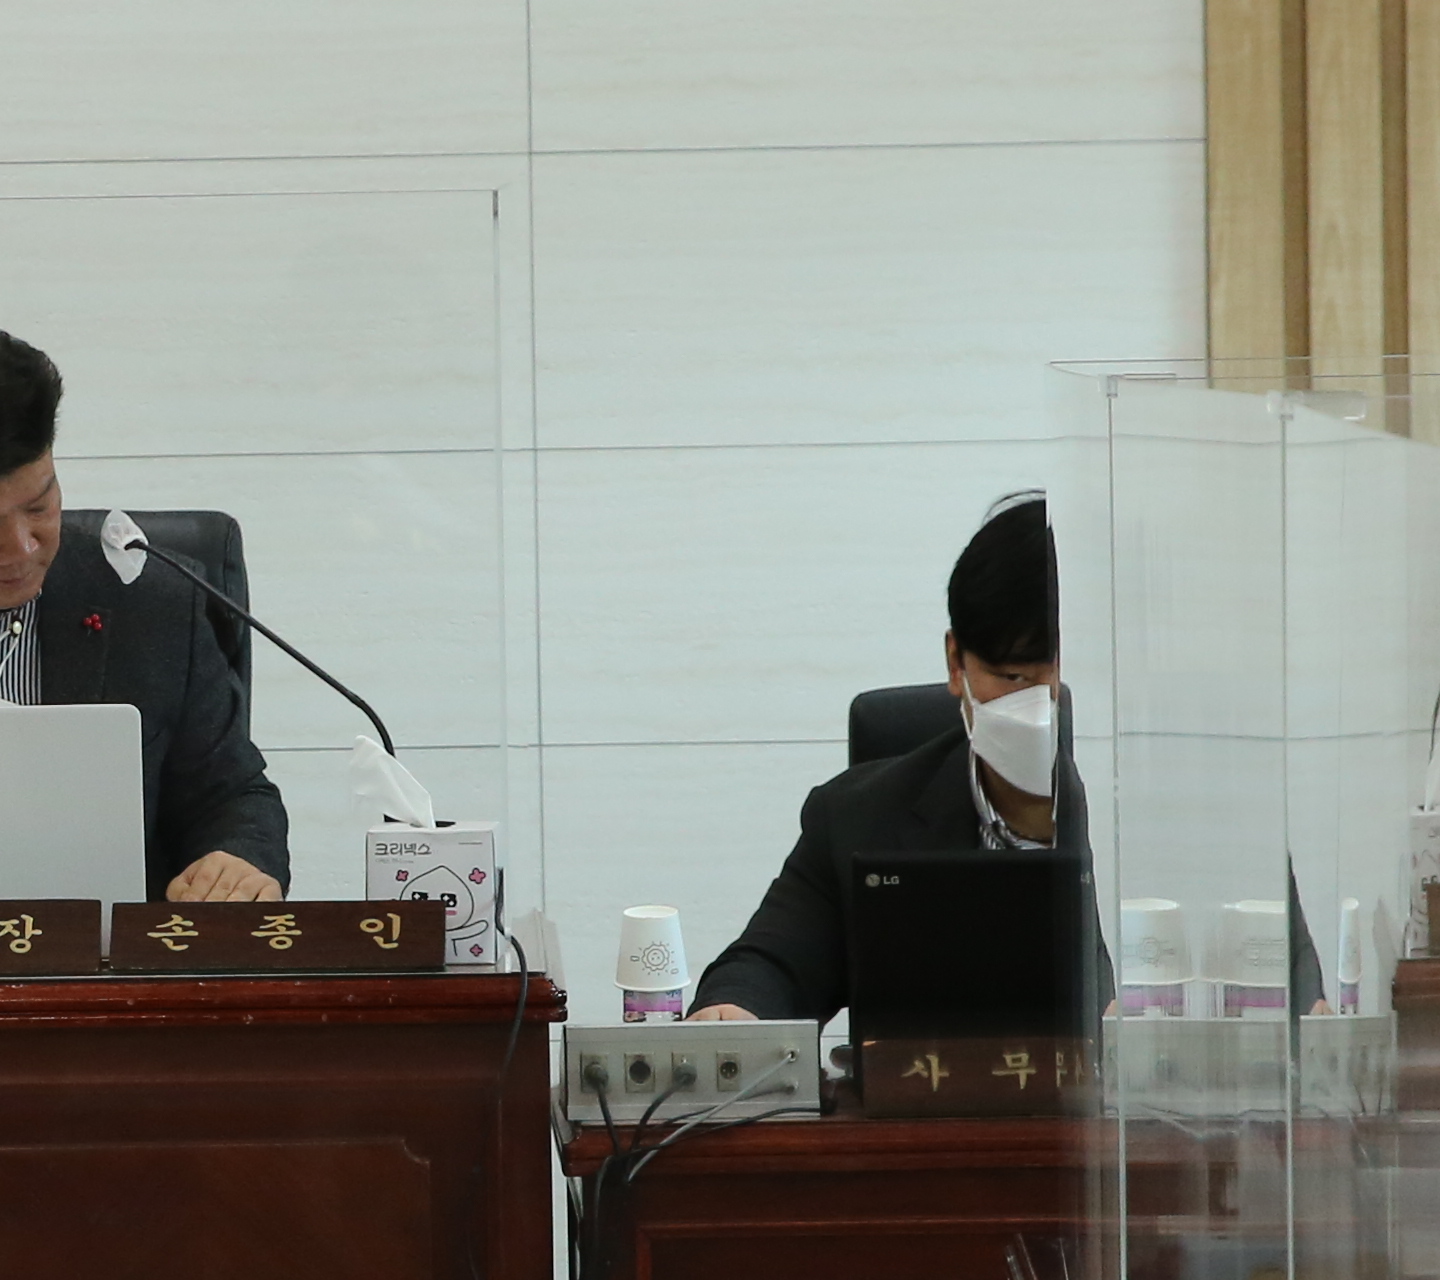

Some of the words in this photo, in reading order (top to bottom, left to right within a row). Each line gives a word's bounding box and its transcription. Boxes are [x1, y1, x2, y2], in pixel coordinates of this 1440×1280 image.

[374, 841, 432, 857] 크리넥스
[882, 875, 900, 885] LG
[146, 912, 402, 952] 손종인
